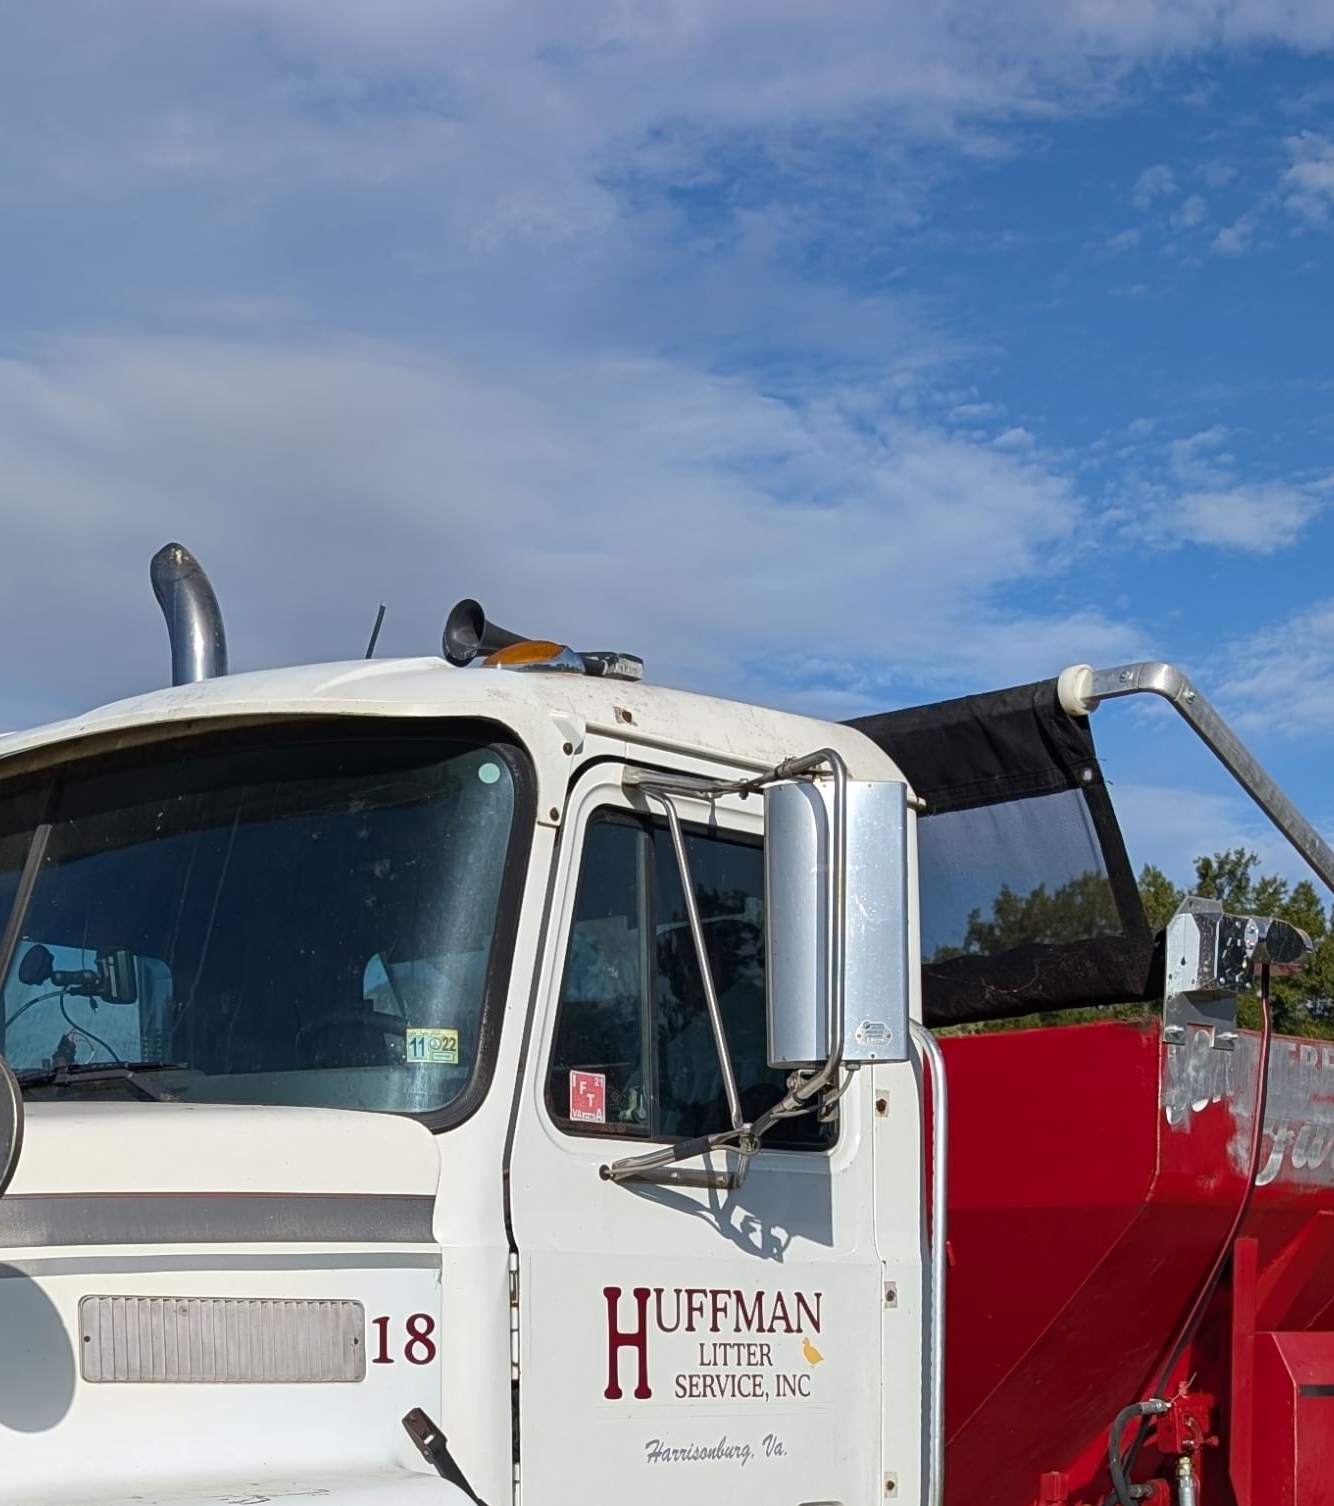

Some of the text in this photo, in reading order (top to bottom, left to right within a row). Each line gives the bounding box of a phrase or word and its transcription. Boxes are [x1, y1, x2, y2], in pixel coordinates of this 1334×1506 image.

[410, 1037, 425, 1057] 11
[442, 1036, 457, 1051] 22
[371, 1313, 437, 1366] 18
[603, 1286, 823, 1400] HUFFMAN
[699, 1343, 773, 1367] LITTER
[675, 1374, 812, 1402] SERVICE, INC
[645, 1433, 788, 1467] Harrisonburg, Va.
